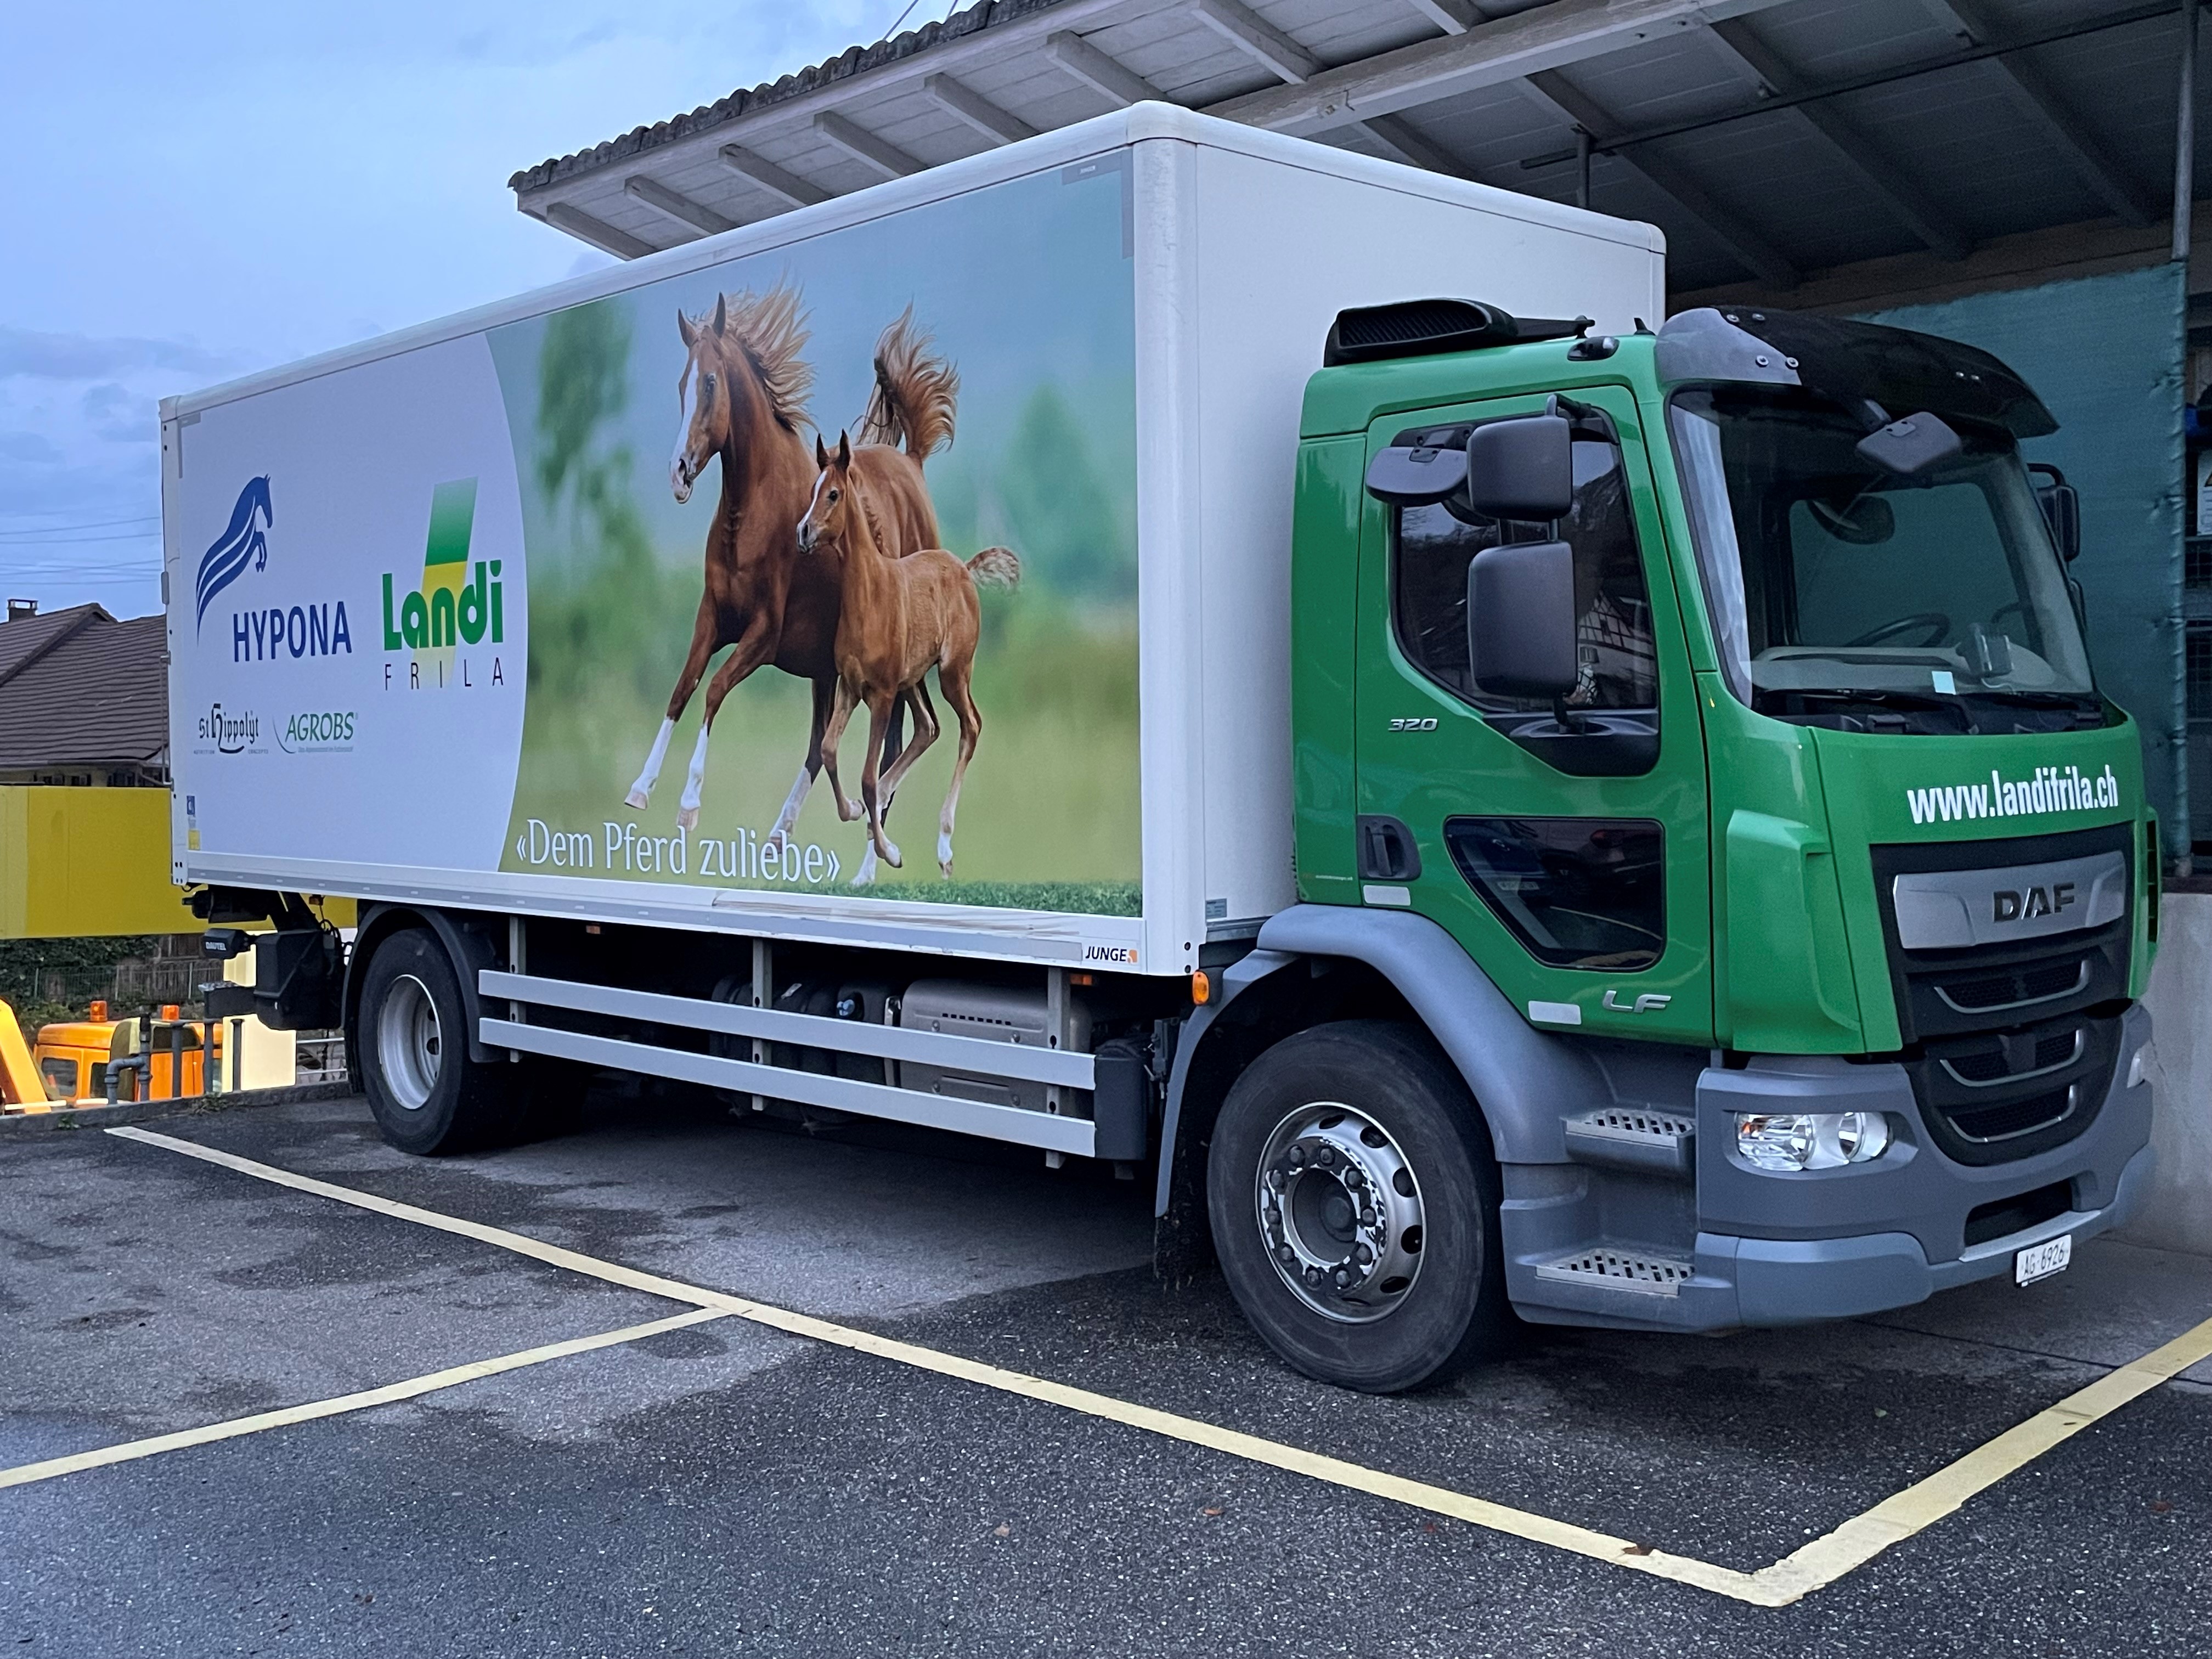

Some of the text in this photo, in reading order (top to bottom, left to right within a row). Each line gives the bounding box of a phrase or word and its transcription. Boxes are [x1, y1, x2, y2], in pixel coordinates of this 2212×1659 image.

[382, 560, 504, 651] Landi
[233, 601, 352, 663] HYPONA
[285, 712, 354, 742] AGROBS
[1387, 718, 1438, 731] 320
[1907, 764, 2119, 825] www.landifrila.ch
[516, 819, 840, 884] «Dem Pferd zuliebe»
[1993, 882, 2075, 923] DAF
[1085, 946, 1127, 962] JUNGE
[1602, 990, 1672, 1014] LF
